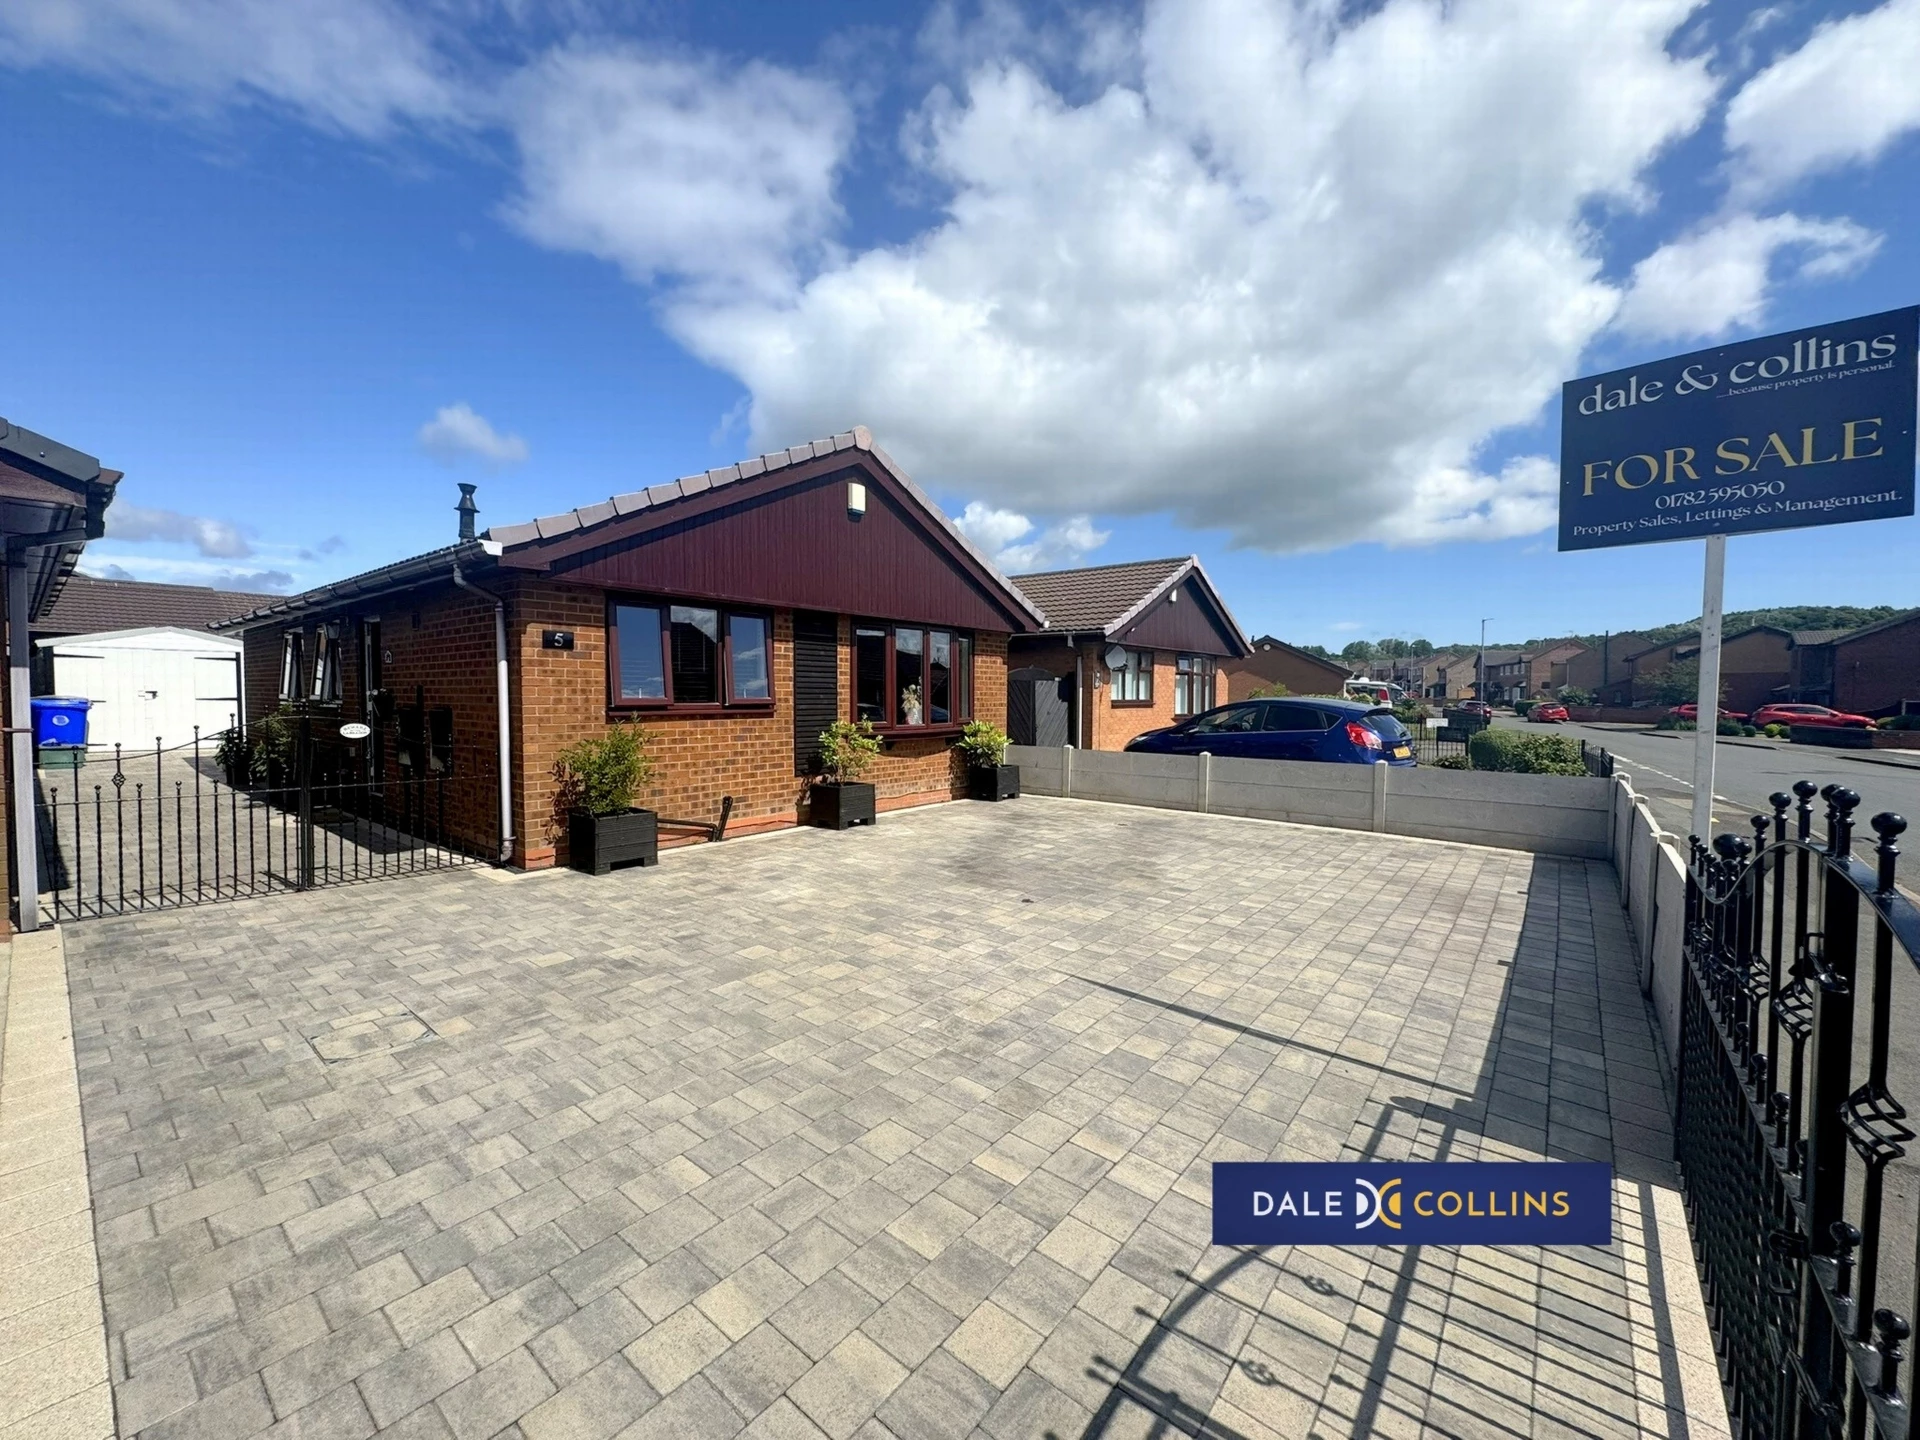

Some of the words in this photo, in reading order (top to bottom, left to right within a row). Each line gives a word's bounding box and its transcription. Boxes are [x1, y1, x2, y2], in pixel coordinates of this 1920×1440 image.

[1579, 375, 1664, 416] dale
[1674, 364, 1719, 396] &
[1729, 334, 1897, 384] collins
[1774, 372, 1826, 391] property
[1582, 447, 1701, 497] FOR
[1714, 417, 1884, 476] SALE
[1573, 520, 1638, 536] Property
[1639, 514, 1682, 528] Sales,
[1685, 505, 1751, 522] Lettings
[1754, 503, 1772, 515] &
[1775, 490, 1903, 513] Management.
[554, 632, 564, 647] 5
